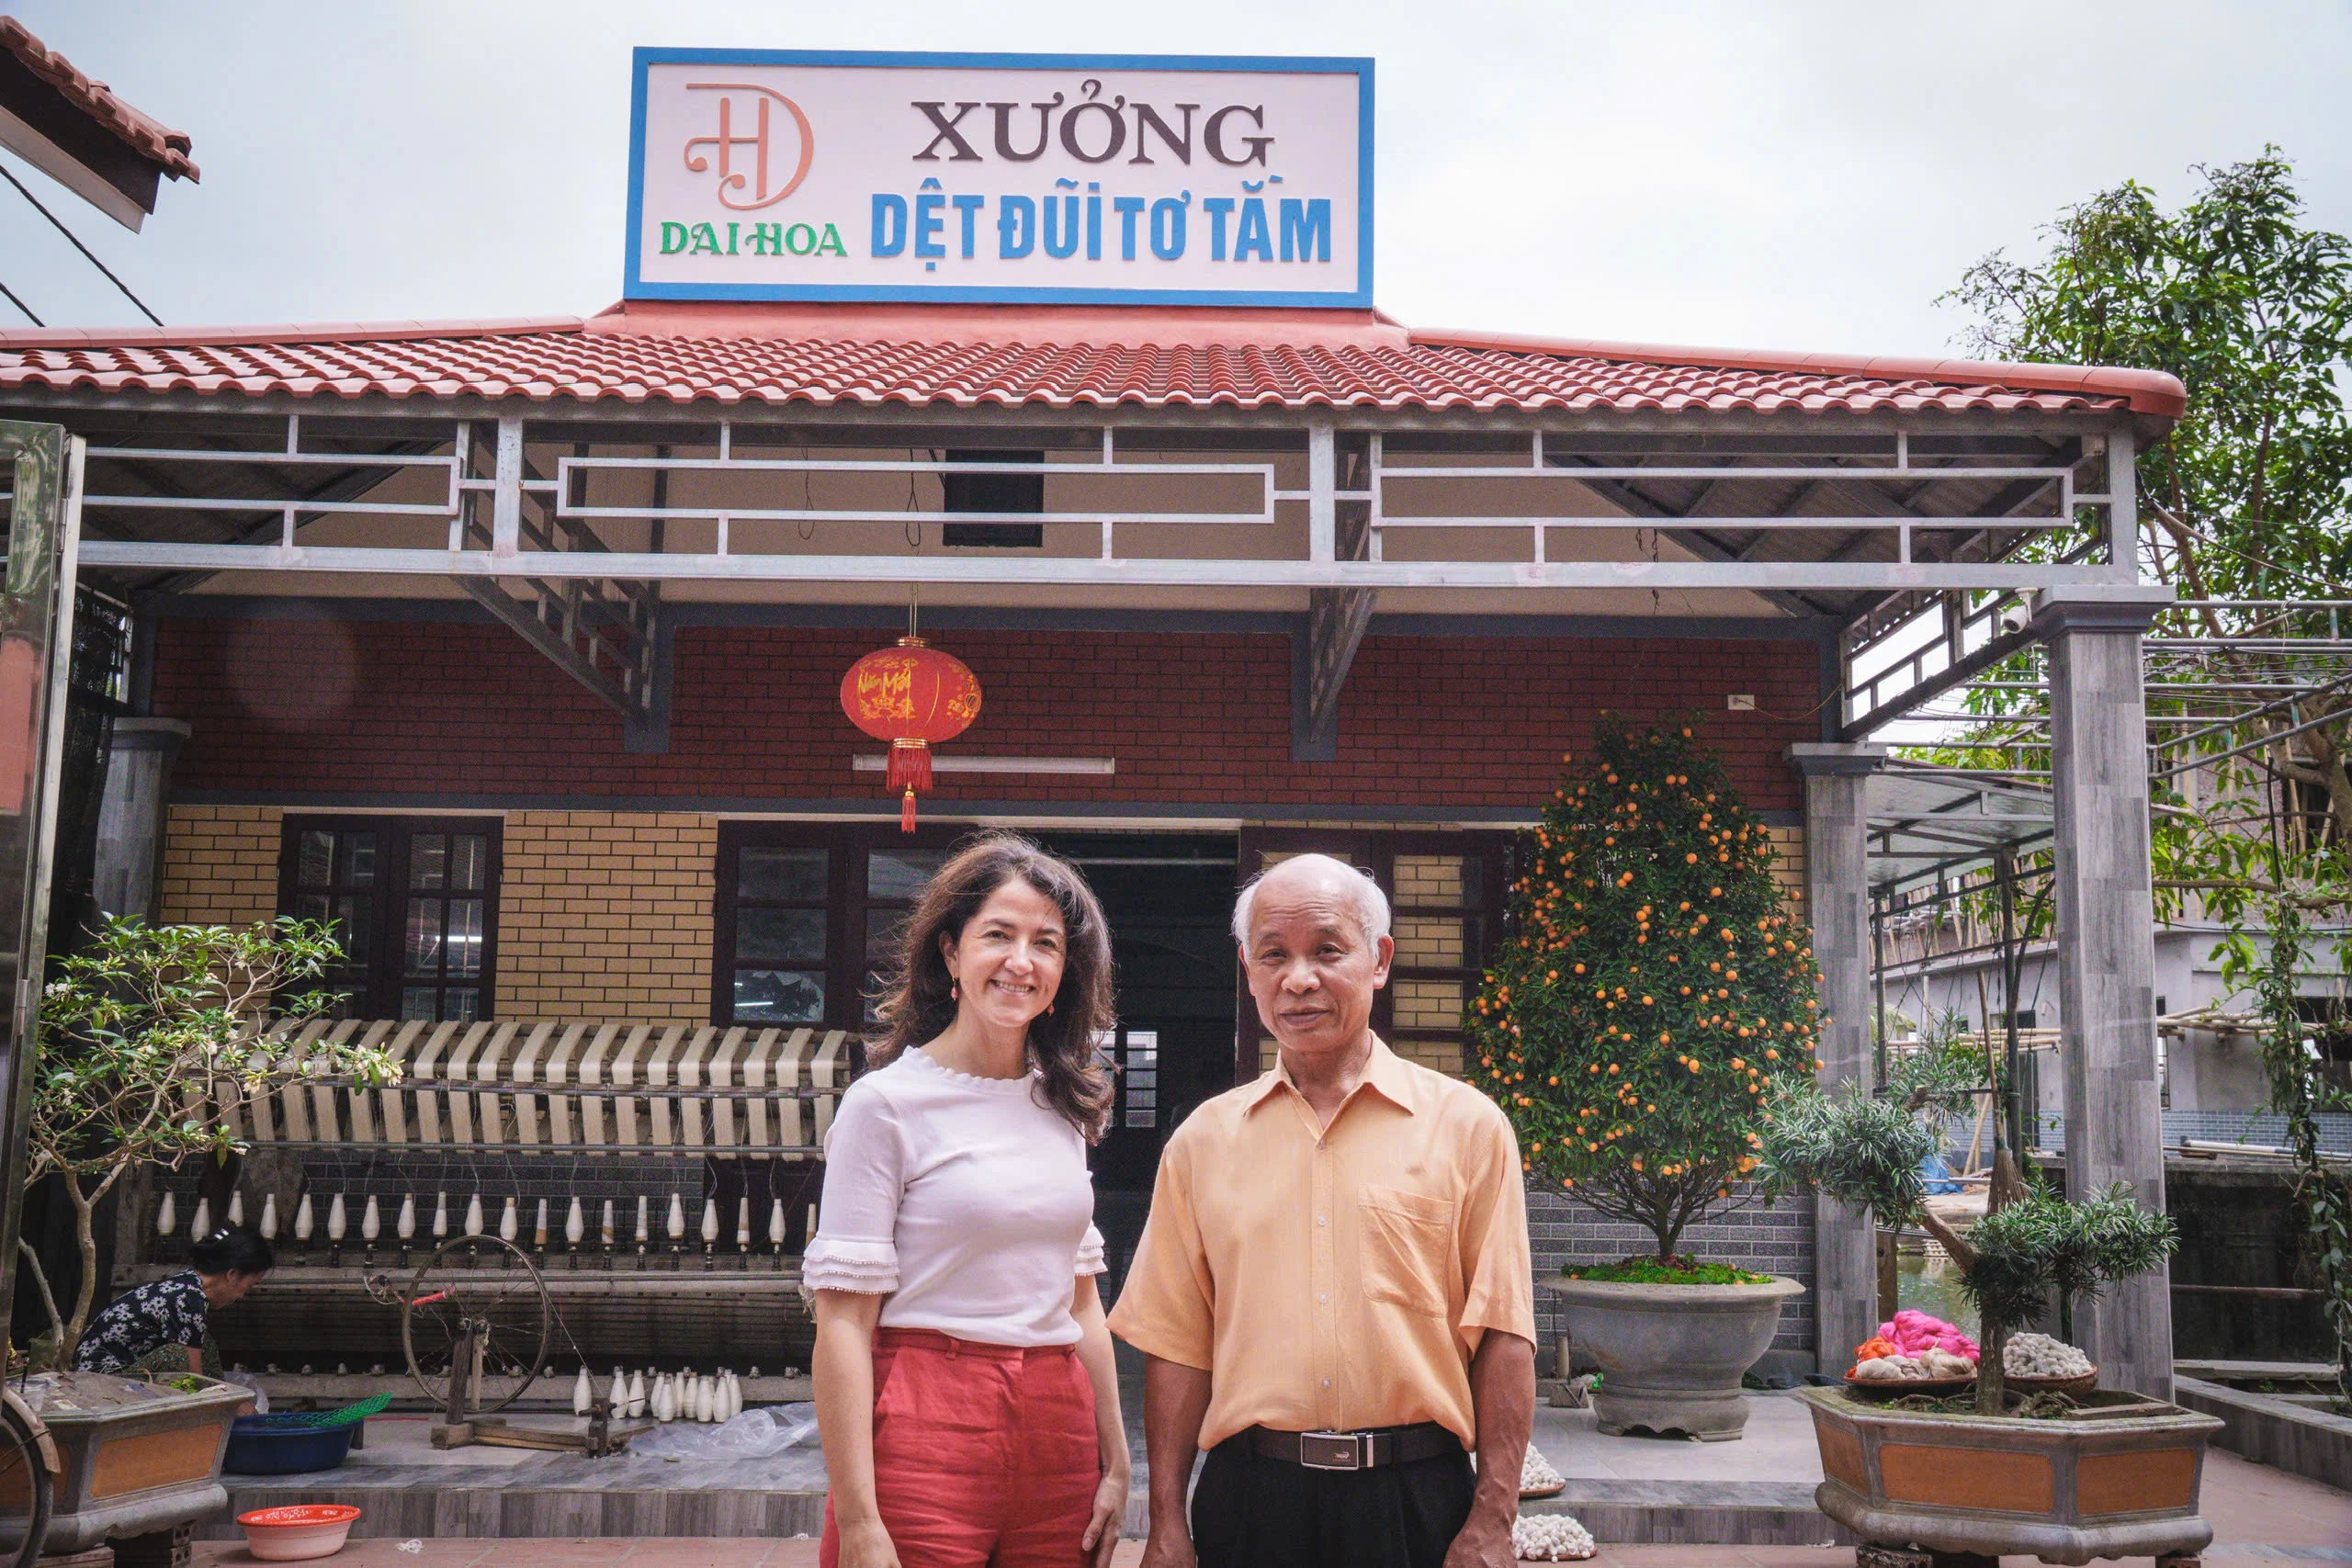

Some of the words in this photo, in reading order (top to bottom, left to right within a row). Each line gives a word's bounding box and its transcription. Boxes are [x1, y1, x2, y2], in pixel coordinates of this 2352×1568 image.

[910, 78, 1275, 167] XƯỞNG
[744, 222, 848, 256] HOA
[871, 177, 985, 271] DỆT
[1114, 189, 1192, 260] TƠ
